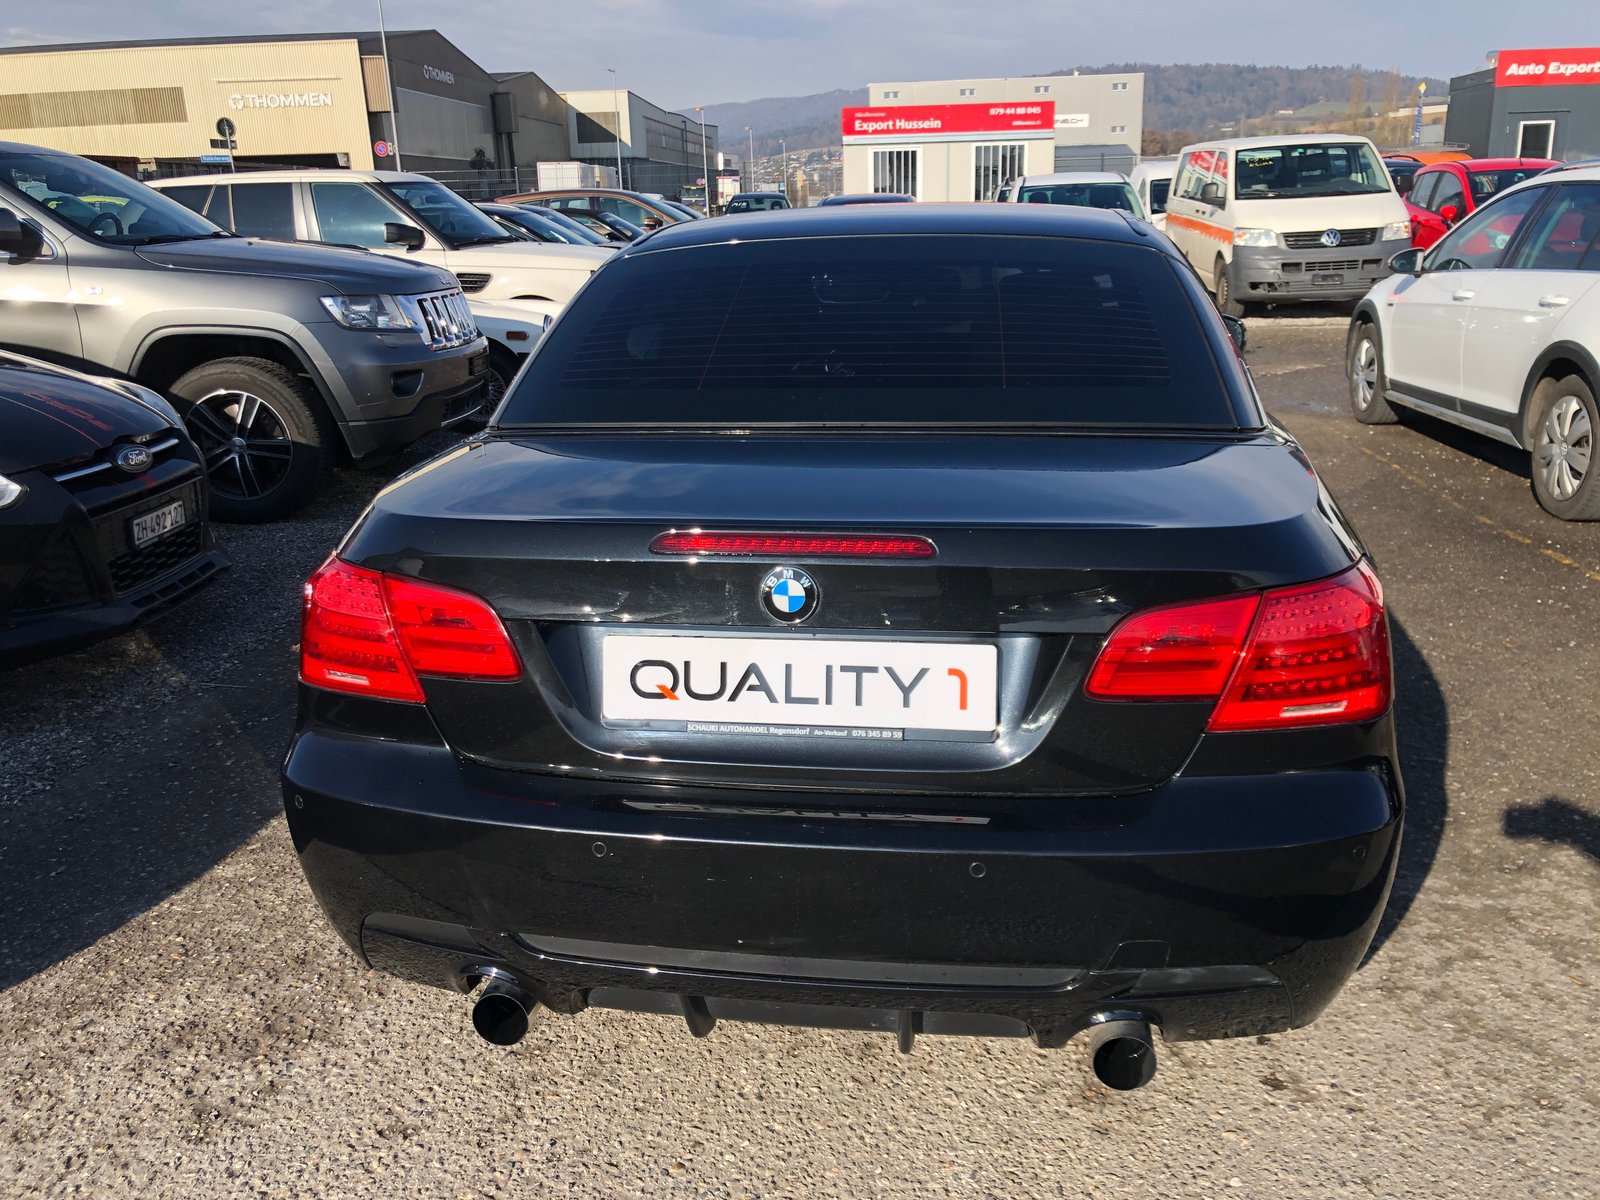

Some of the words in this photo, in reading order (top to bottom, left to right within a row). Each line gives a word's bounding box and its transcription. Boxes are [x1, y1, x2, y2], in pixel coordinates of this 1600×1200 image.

[1505, 62, 1545, 76] Auto
[1547, 61, 1600, 76] Export
[247, 93, 332, 108] THOMMEN
[989, 108, 1005, 116] 079
[854, 119, 894, 133] Export
[895, 118, 942, 130] Hussein
[127, 450, 148, 465] Ford
[765, 569, 812, 588] BMW
[629, 659, 931, 709] QUALITY
[947, 667, 968, 711] 1
[687, 723, 719, 732] SCHAUKI
[719, 725, 769, 734] AUTOHANDEL
[769, 727, 810, 735] Regensdorf
[867, 730, 881, 738] 345
[893, 731, 903, 739] 59
